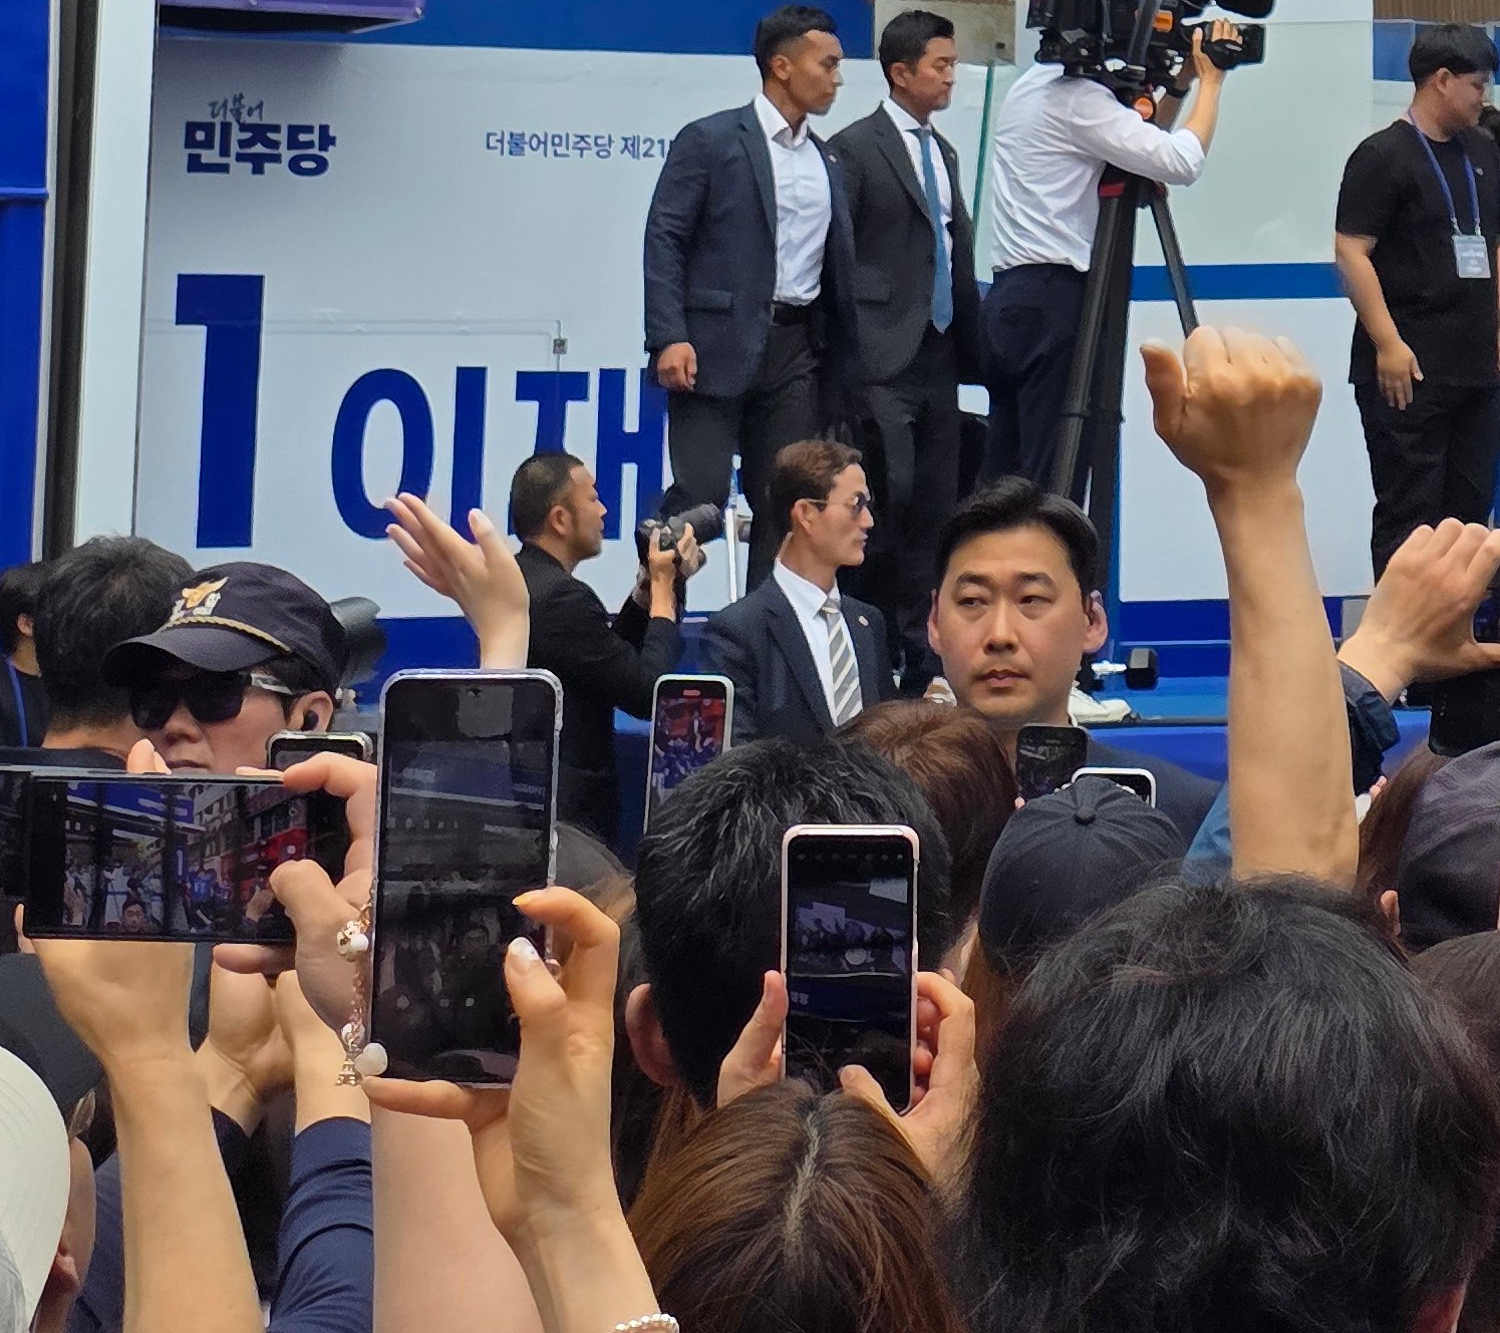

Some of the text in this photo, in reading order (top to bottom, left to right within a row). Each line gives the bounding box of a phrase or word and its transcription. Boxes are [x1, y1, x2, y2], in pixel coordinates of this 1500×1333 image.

[207, 92, 264, 123] 더불어
[184, 120, 337, 177] 민주당
[485, 130, 673, 161] 더불어민주당 제21
[176, 274, 265, 548] 1
[331, 366, 671, 541] 이재
